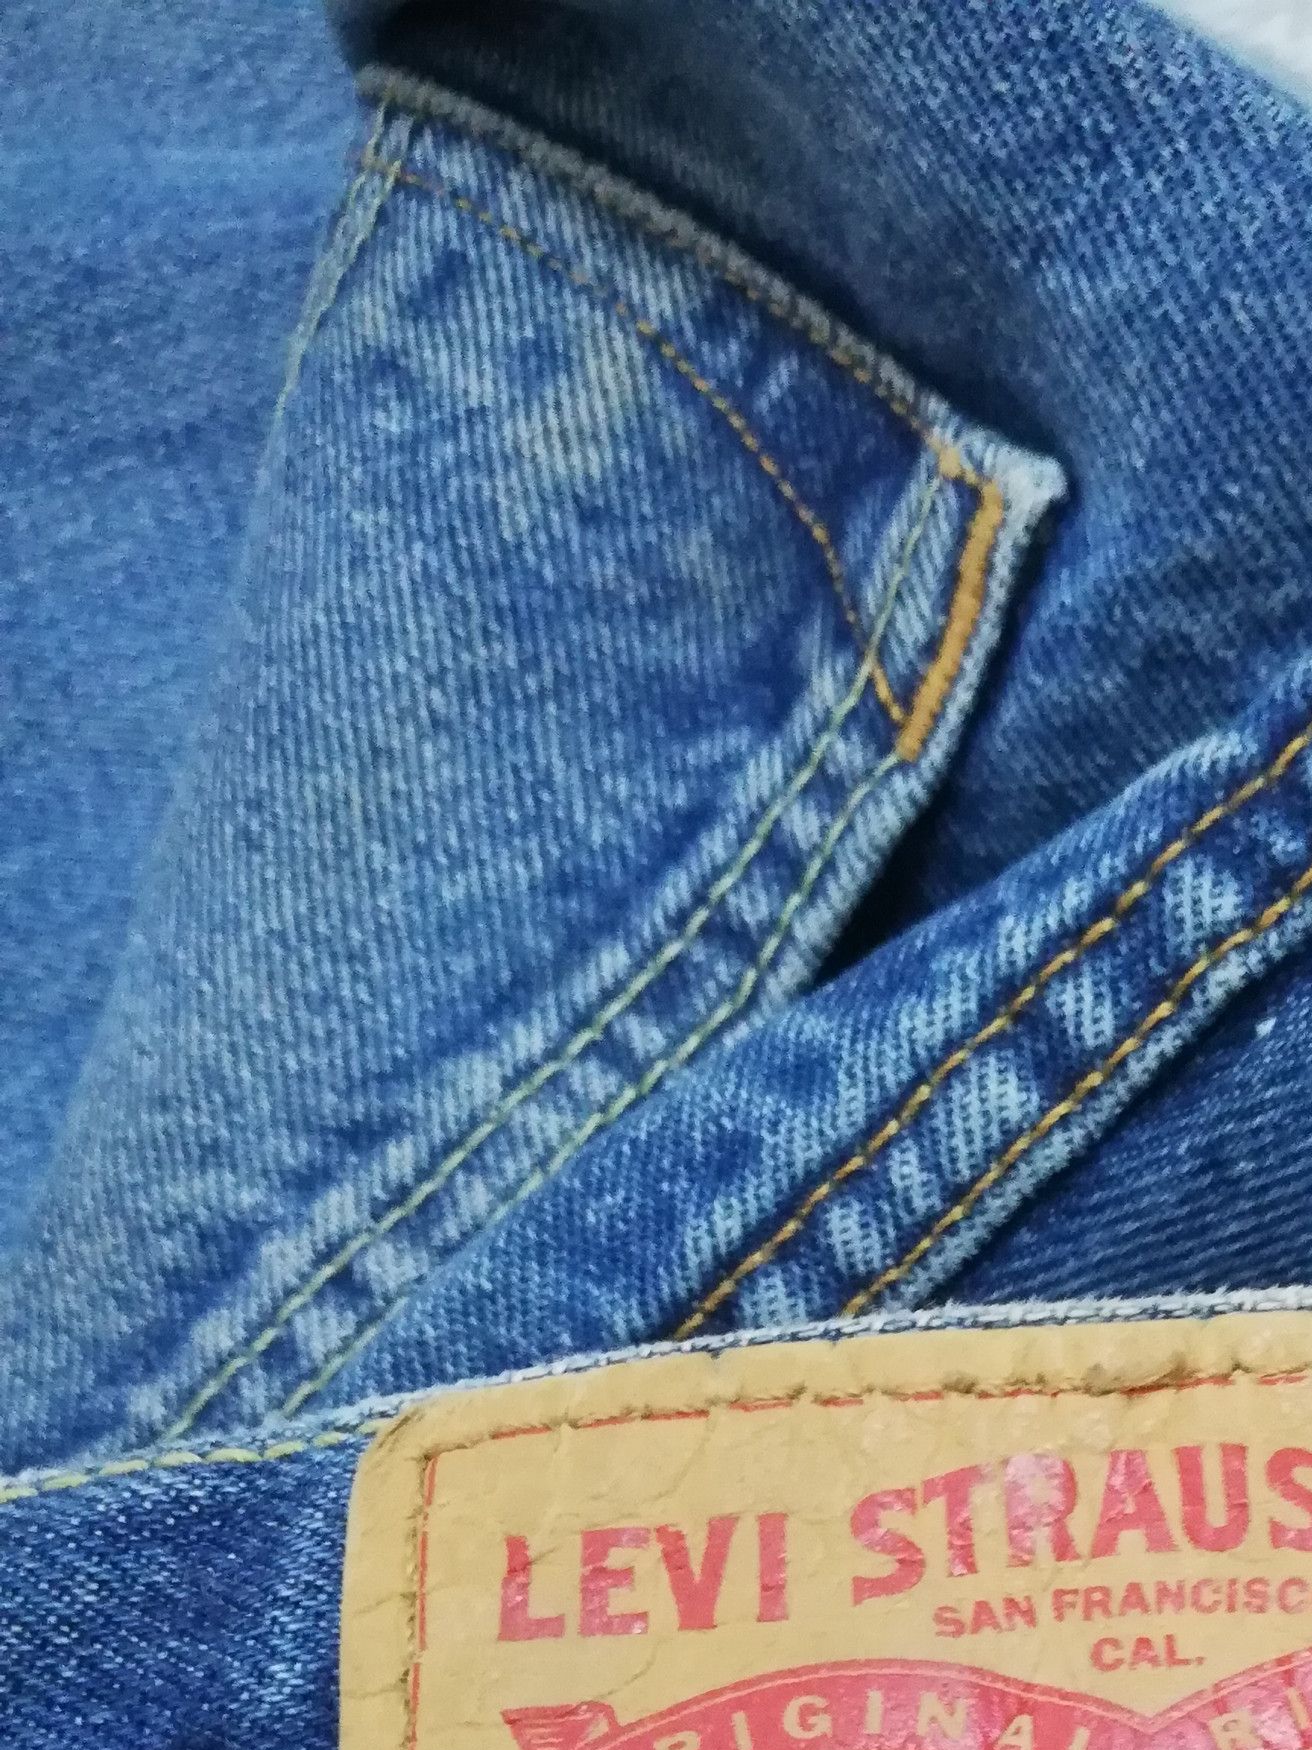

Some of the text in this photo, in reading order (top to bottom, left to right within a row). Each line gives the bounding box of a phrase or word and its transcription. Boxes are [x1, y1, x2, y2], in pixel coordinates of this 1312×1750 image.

[497, 1512, 790, 1642] LEVI
[932, 1596, 1038, 1639] SAN
[1089, 1633, 1207, 1673] CAL.
